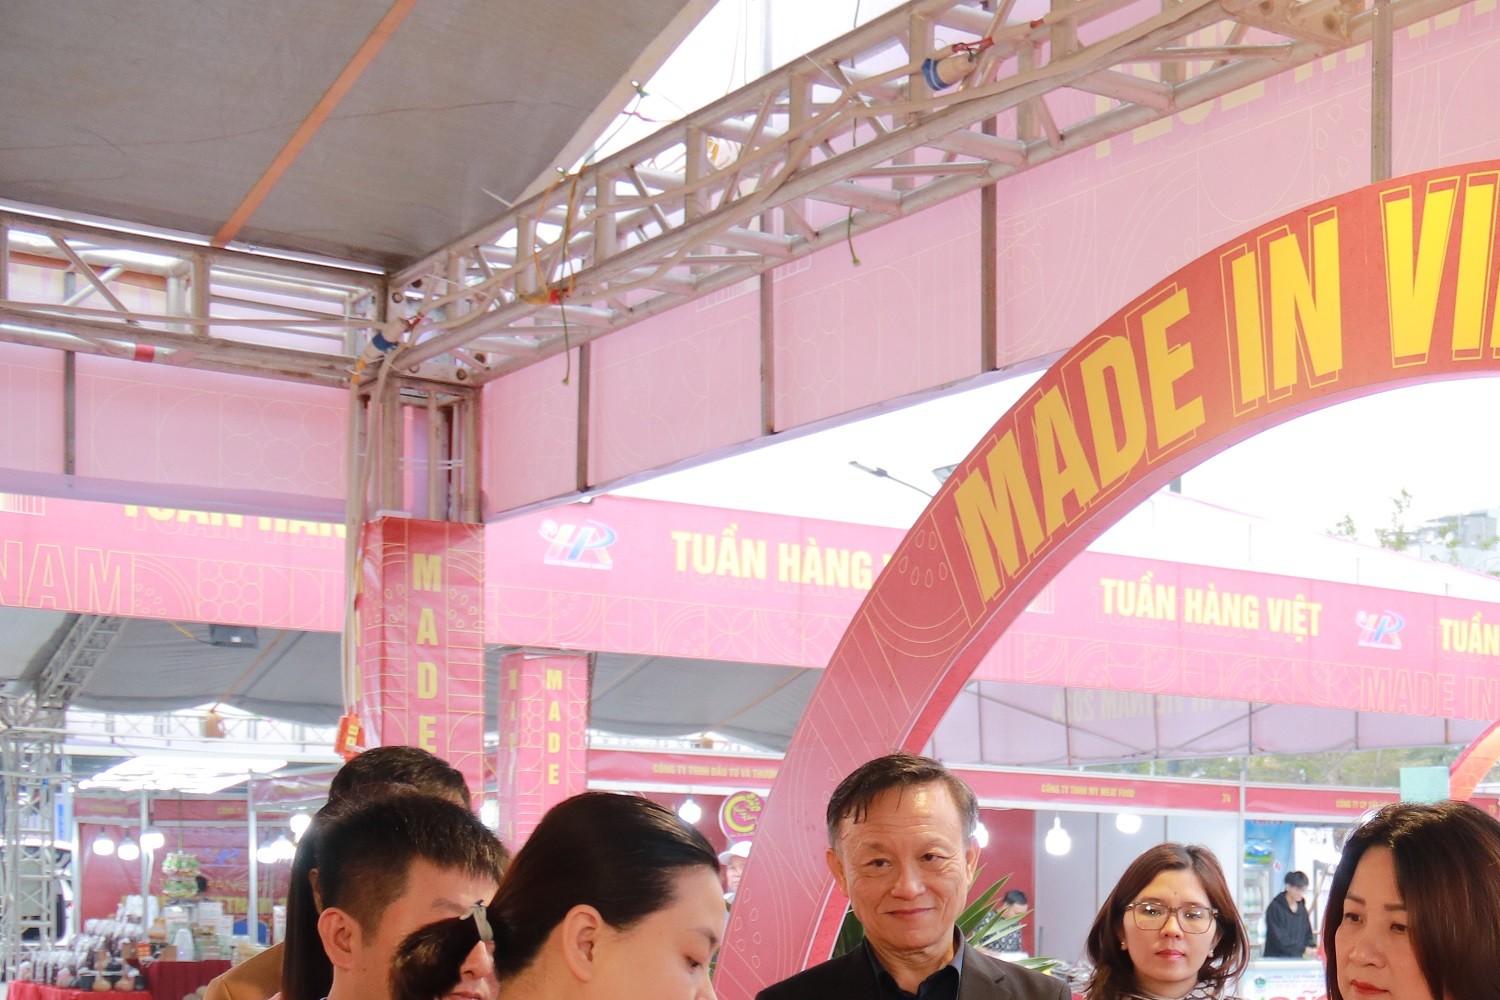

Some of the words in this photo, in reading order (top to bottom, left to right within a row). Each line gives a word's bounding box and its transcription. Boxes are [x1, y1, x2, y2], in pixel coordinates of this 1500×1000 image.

[953, 284, 1207, 602] MADE
[1226, 207, 1344, 408] IN
[670, 522, 767, 581] TUẦN
[778, 537, 873, 591] HÀNG
[412, 552, 442, 754] MADE
[1100, 570, 1177, 622] TUẦN
[1184, 583, 1260, 631] HÀNG
[1267, 594, 1323, 643] VIỆT
[1439, 611, 1500, 657] TUẦN
[544, 668, 564, 786] MADE
